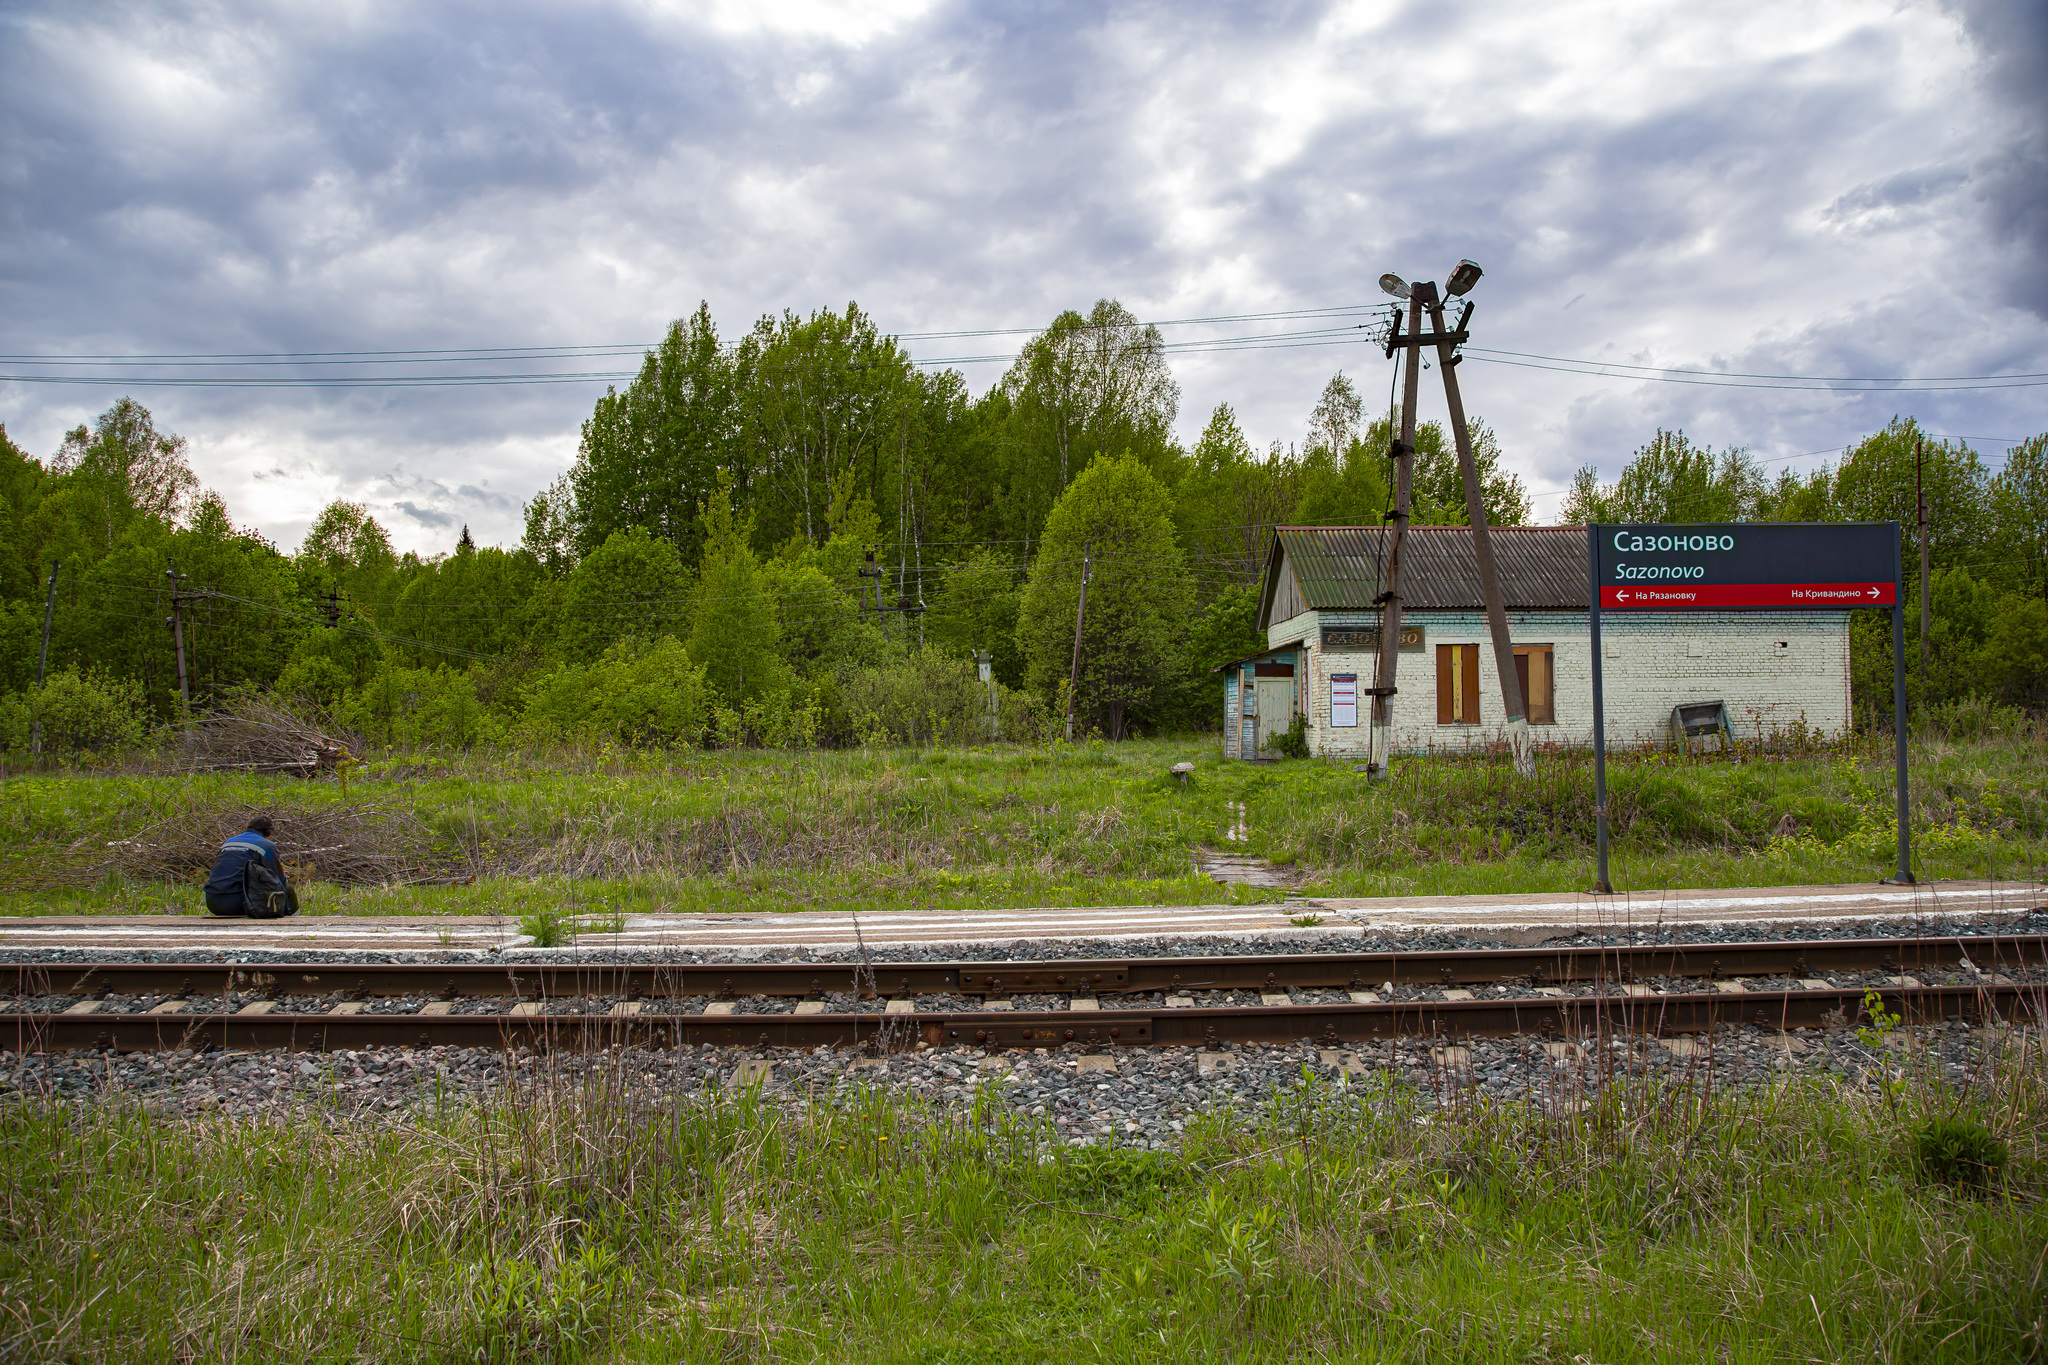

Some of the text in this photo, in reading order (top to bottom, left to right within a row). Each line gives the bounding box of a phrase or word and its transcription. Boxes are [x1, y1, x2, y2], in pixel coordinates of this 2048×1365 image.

[1613, 530, 1735, 552] Сазоново
[1615, 563, 1705, 580] Sazonovo
[1635, 591, 1697, 602] На Рязановку
[1791, 589, 1861, 600] На Кривандино
